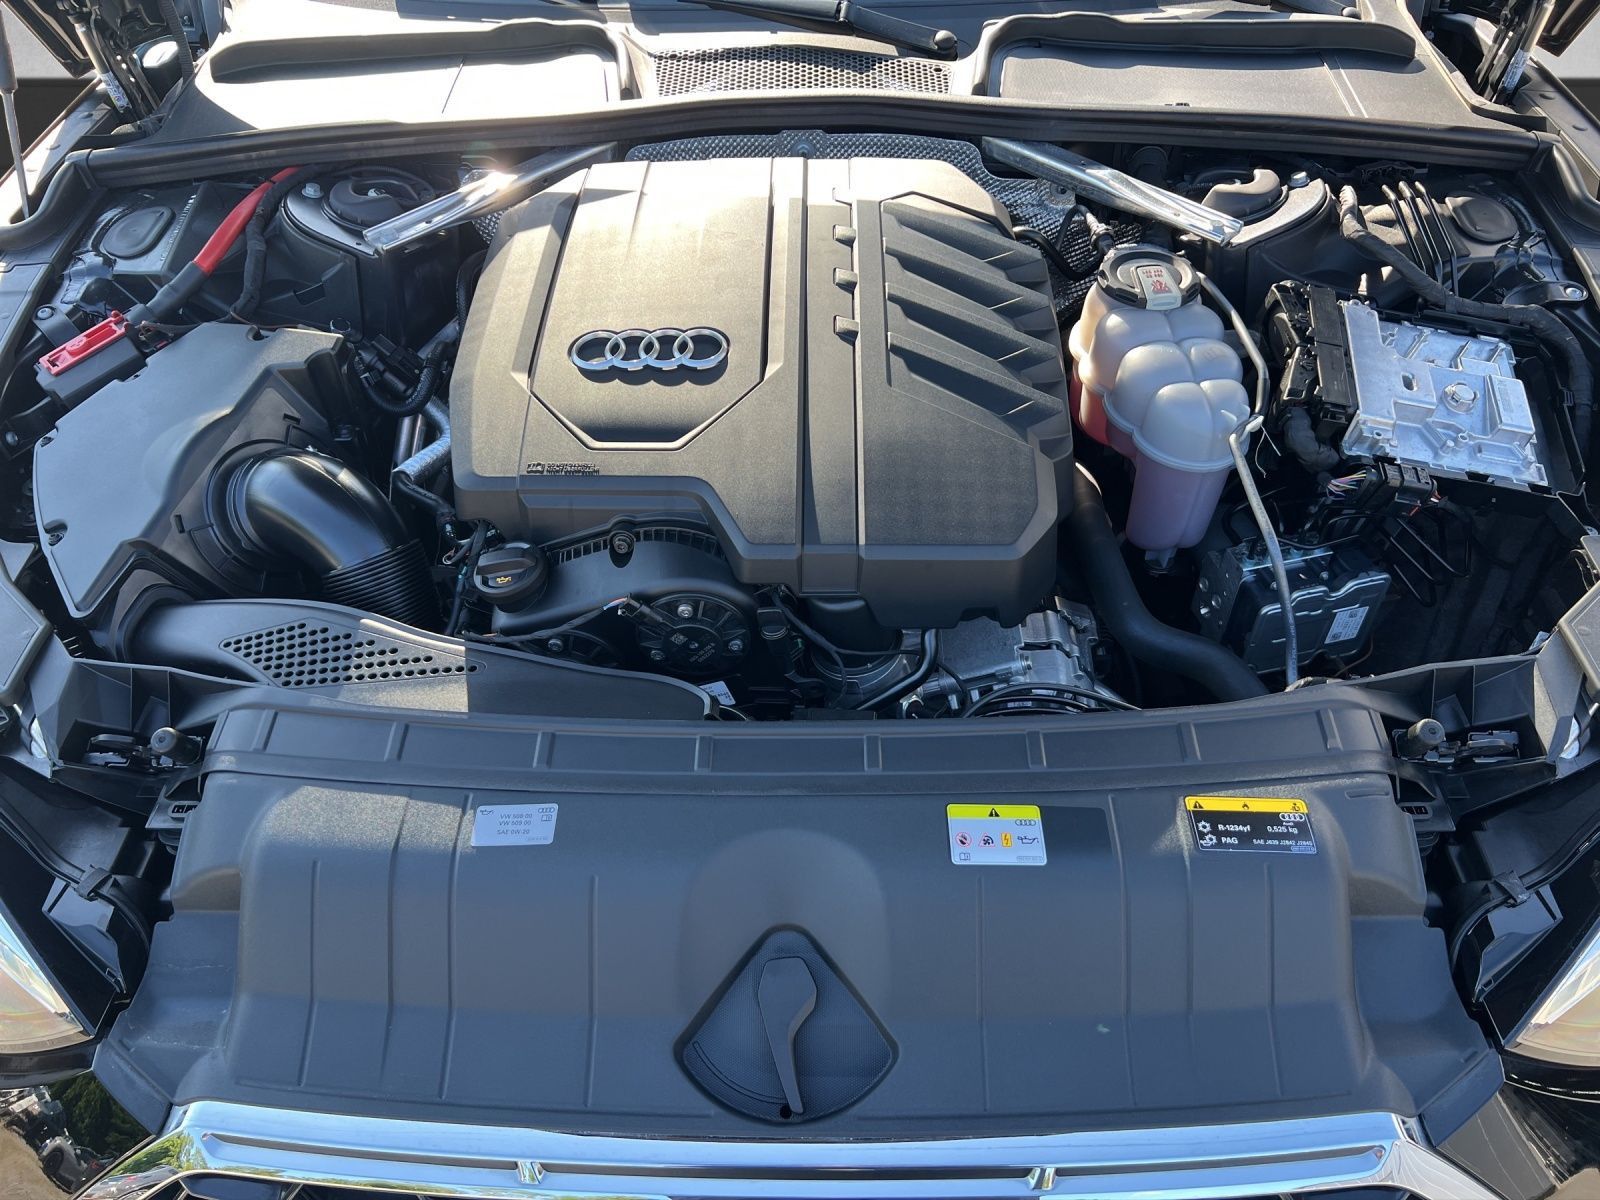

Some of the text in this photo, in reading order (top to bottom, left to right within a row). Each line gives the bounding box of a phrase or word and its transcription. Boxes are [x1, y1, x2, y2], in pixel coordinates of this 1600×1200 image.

[1217, 824, 1251, 833] R-1234yf
[1288, 826, 1299, 834] kg
[1221, 836, 1239, 844] PAG
